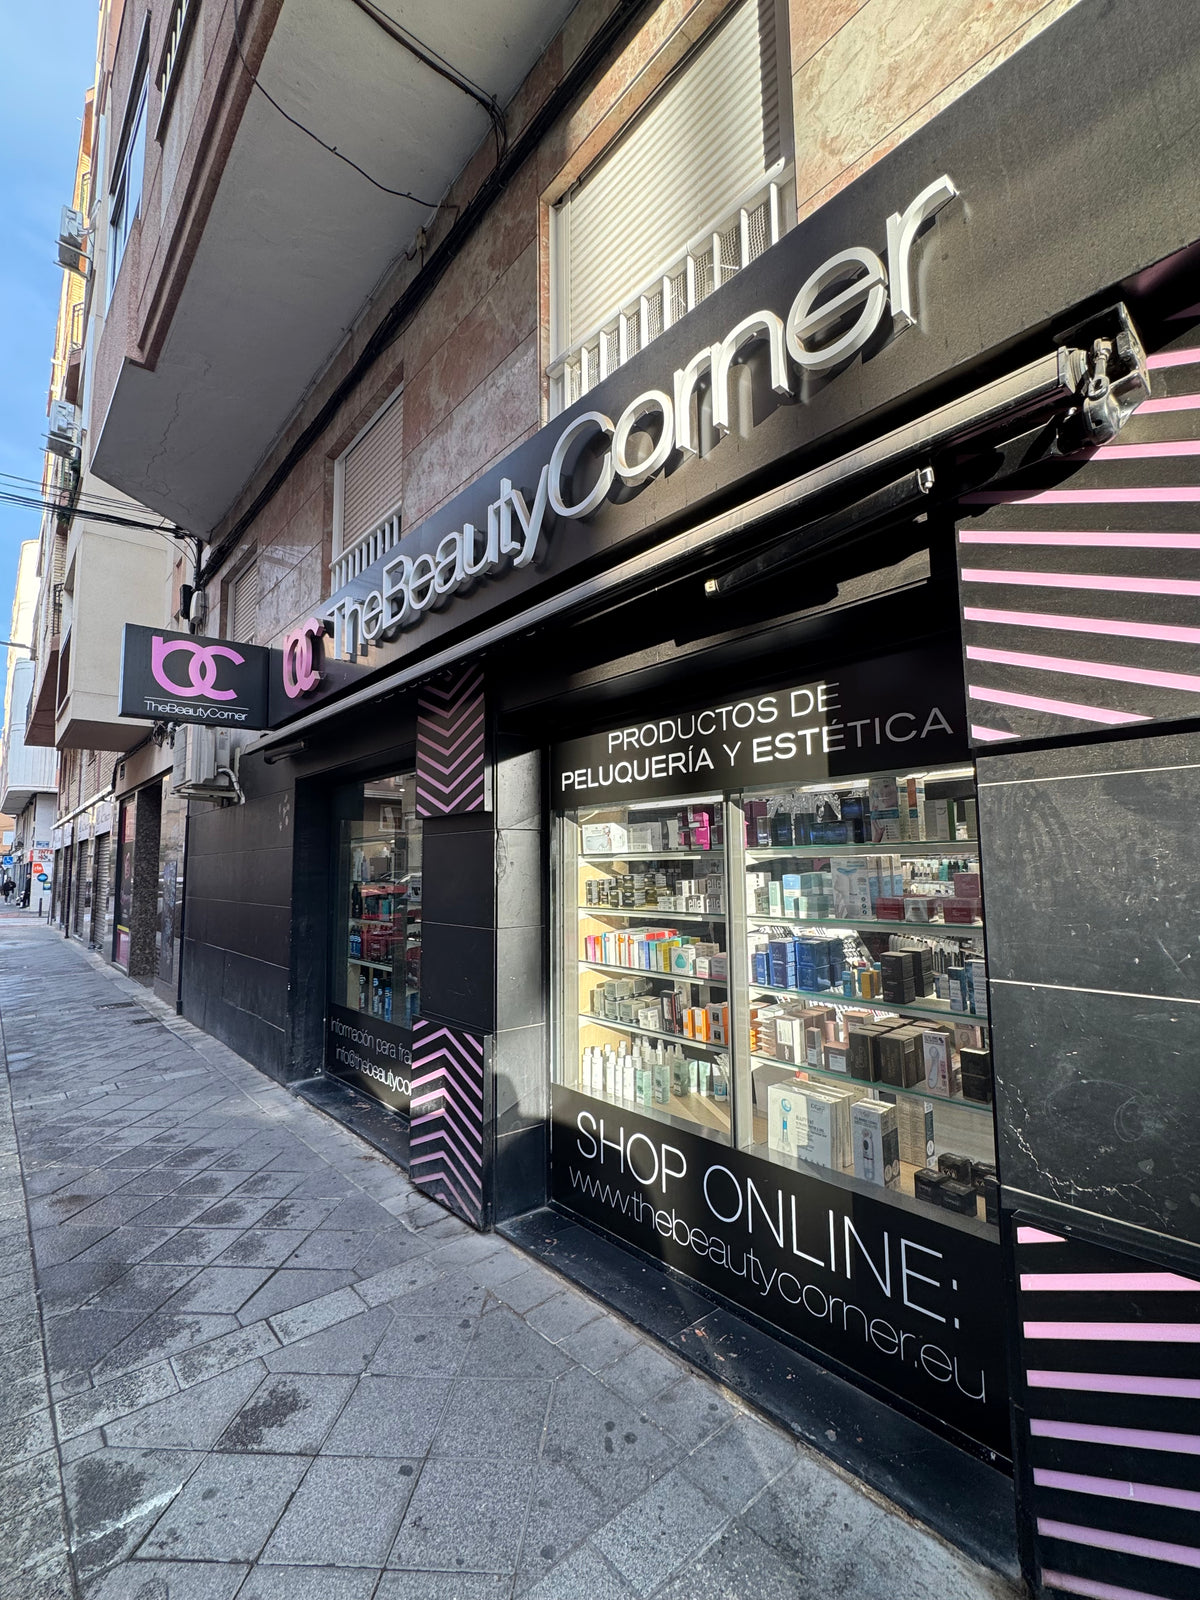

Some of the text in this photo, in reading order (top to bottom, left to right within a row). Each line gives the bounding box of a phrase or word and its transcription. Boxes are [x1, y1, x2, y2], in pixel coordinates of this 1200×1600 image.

[327, 174, 959, 661] TheBeautyCorner
[144, 700, 248, 721] TheBeautyCorner
[561, 706, 953, 791] PELUQUERÍA Y ESTÉTICA
[608, 682, 842, 753] PRODUCTOS DE
[376, 1038, 397, 1058] para
[577, 1111, 960, 1329] SHOP ONLINE:
[569, 1166, 986, 1404] www.thebeautycorner.eu
